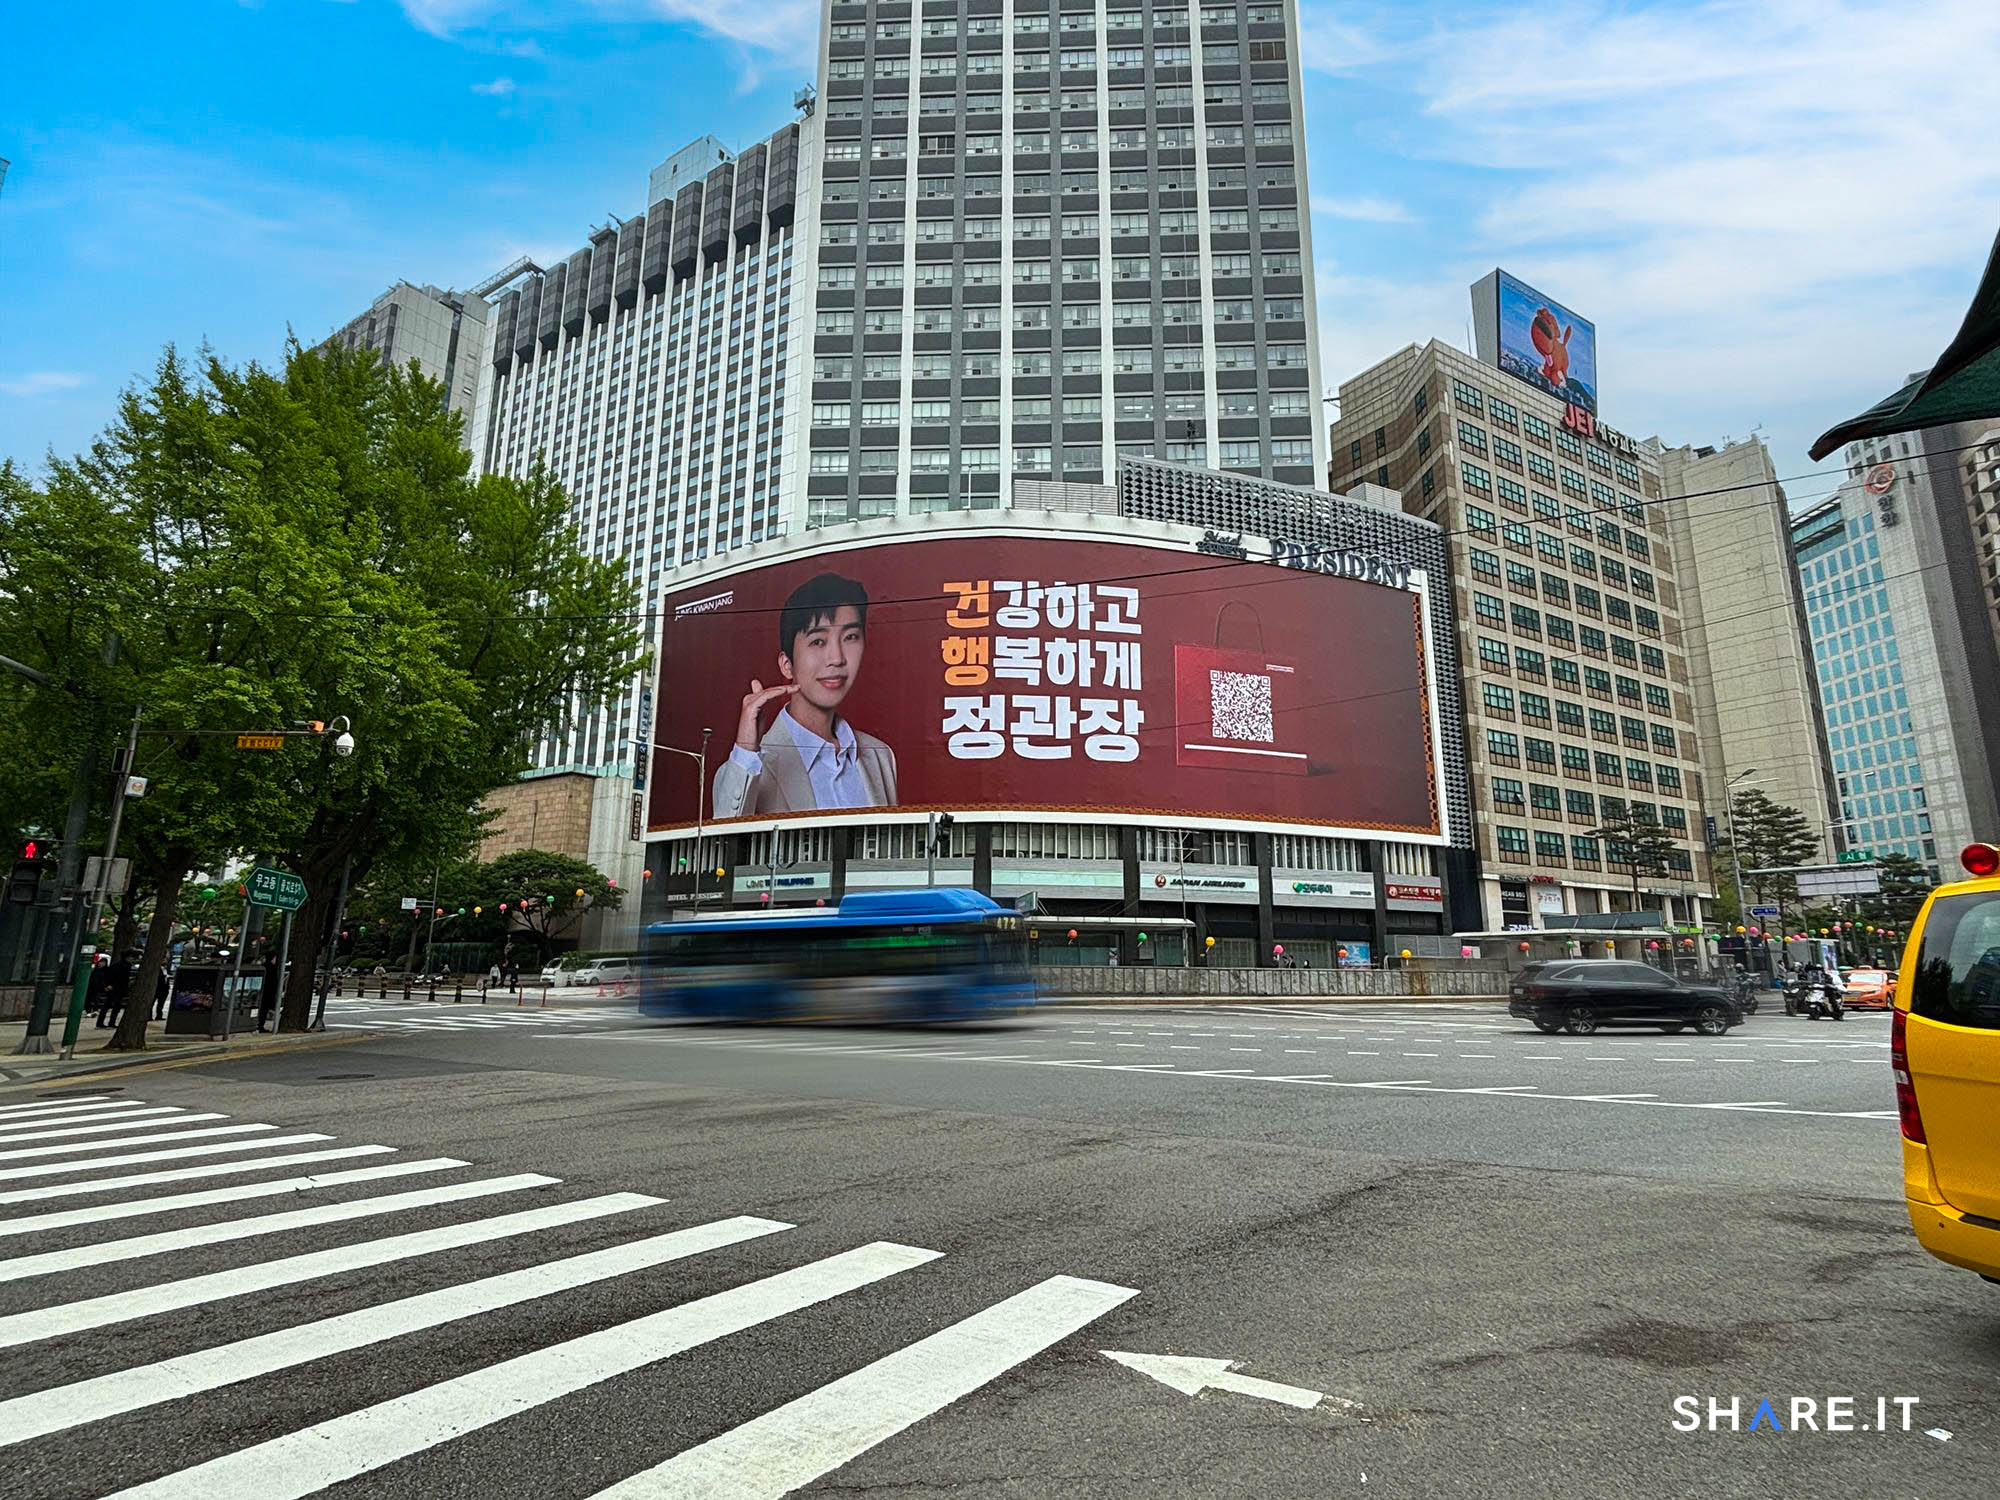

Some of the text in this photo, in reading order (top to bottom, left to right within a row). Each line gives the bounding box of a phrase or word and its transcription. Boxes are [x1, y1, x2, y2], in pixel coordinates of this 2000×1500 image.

[1563, 403, 1594, 438] JEI
[1269, 536, 1412, 590] PRESIDENT
[693, 602, 715, 614] KWAN
[714, 596, 734, 611] JANG
[943, 580, 1142, 634] 건강하고
[941, 636, 1142, 690] 행복하게
[942, 694, 1145, 762] 정관장
[256, 873, 277, 890] 무교동
[1170, 879, 1246, 889] JAPAN AIRLINES
[996, 917, 1016, 929] 472
